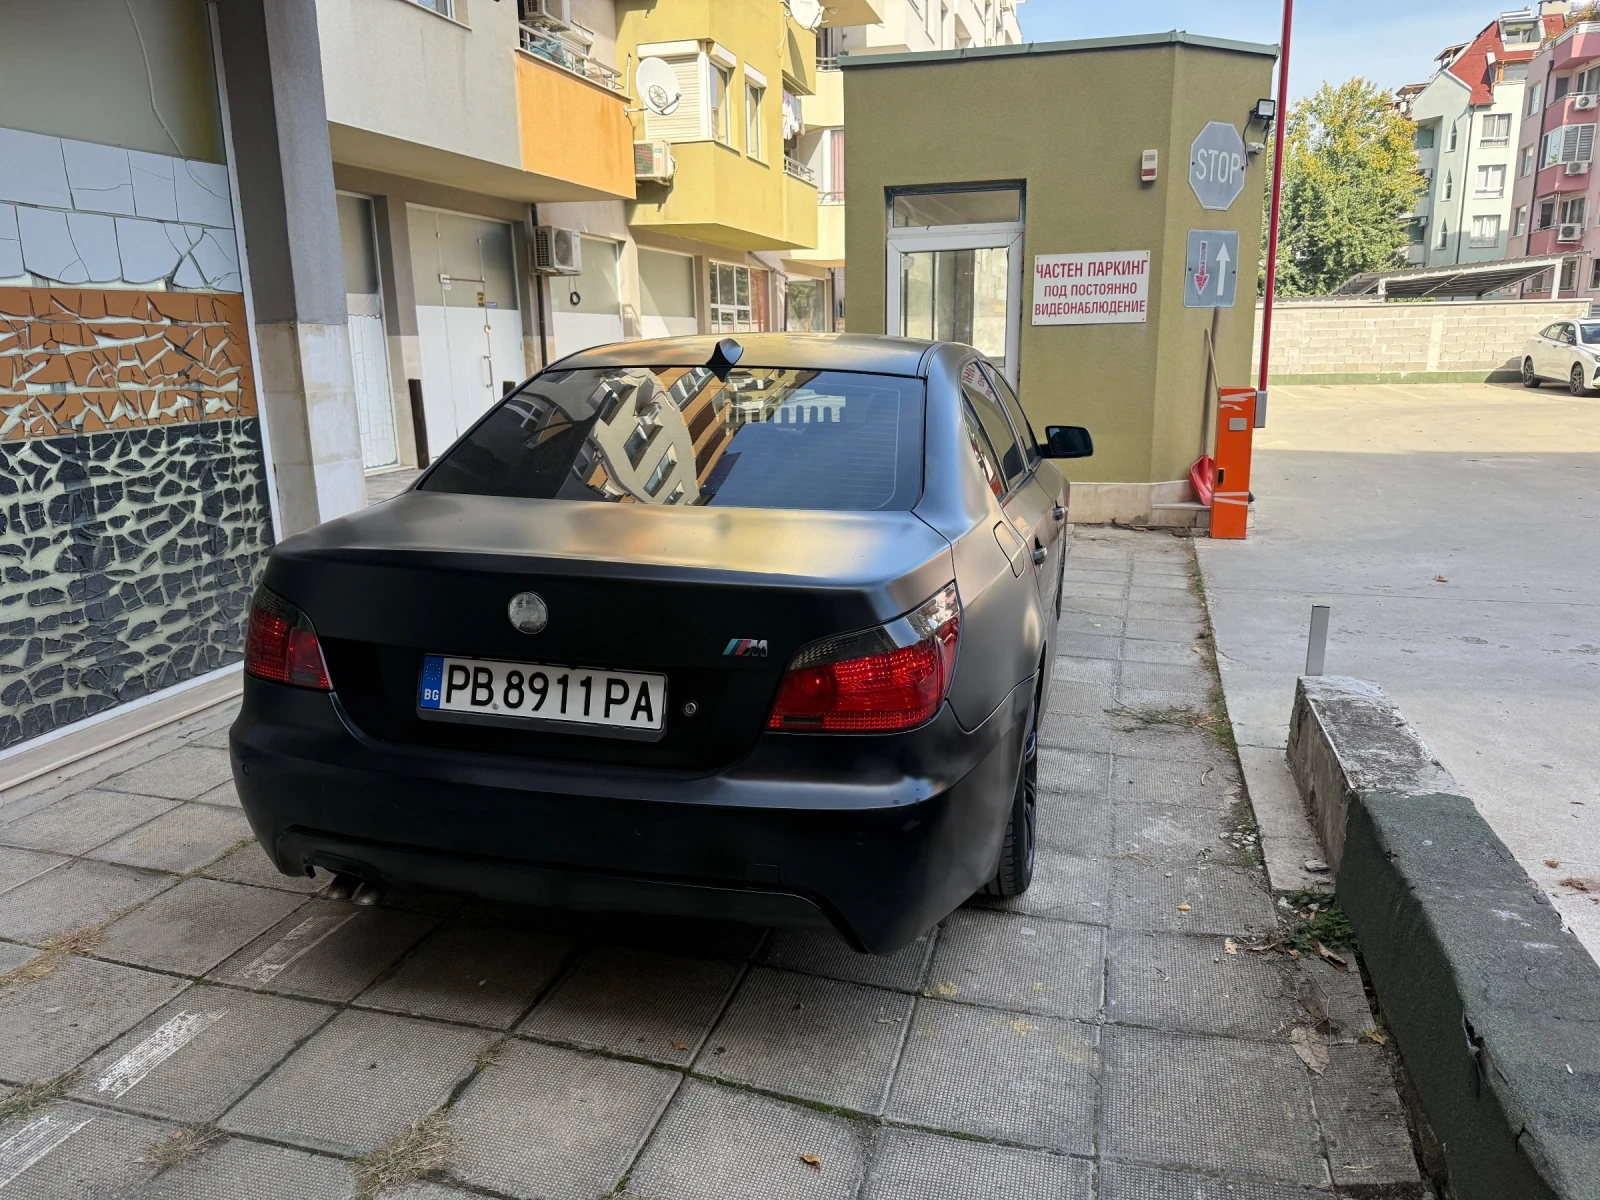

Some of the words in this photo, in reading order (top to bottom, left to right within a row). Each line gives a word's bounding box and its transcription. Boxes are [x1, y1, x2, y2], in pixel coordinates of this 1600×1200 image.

[1195, 148, 1241, 184] STOP
[1036, 262, 1083, 279] ЧАСТЕН
[1087, 259, 1148, 277] ПАРКИНГ
[1044, 284, 1067, 299] ПОД
[1070, 282, 1137, 297] ПОСТОЯННО
[1034, 300, 1145, 317] ВИДЕОНАБЛЮДЕНИЕ
[424, 688, 440, 701] BG
